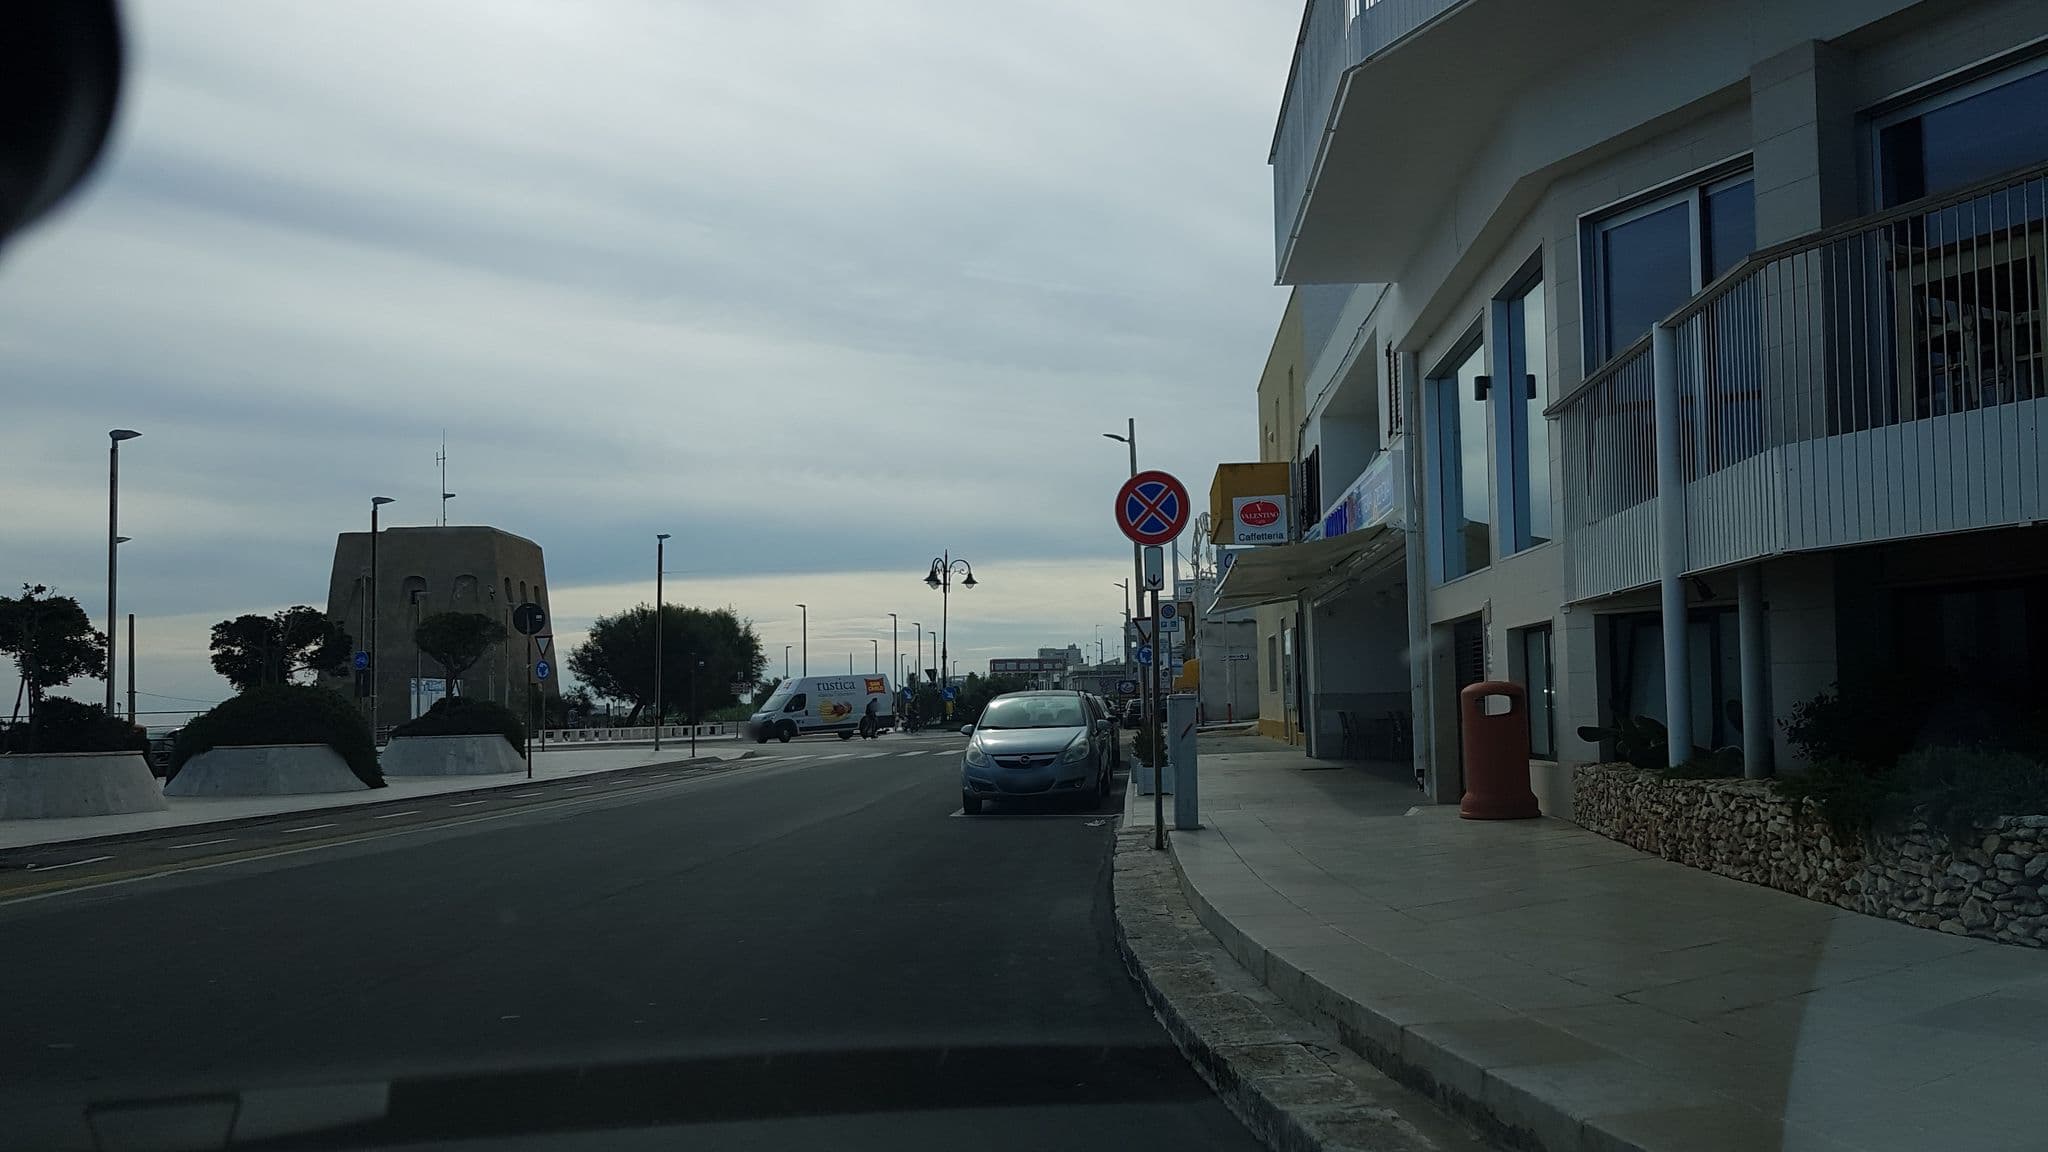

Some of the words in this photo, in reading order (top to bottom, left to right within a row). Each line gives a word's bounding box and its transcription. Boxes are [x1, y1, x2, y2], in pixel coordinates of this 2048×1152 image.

[1241, 512, 1279, 520] VALENTINO
[1238, 532, 1284, 541] Caffetteria
[817, 678, 856, 691] rustica
